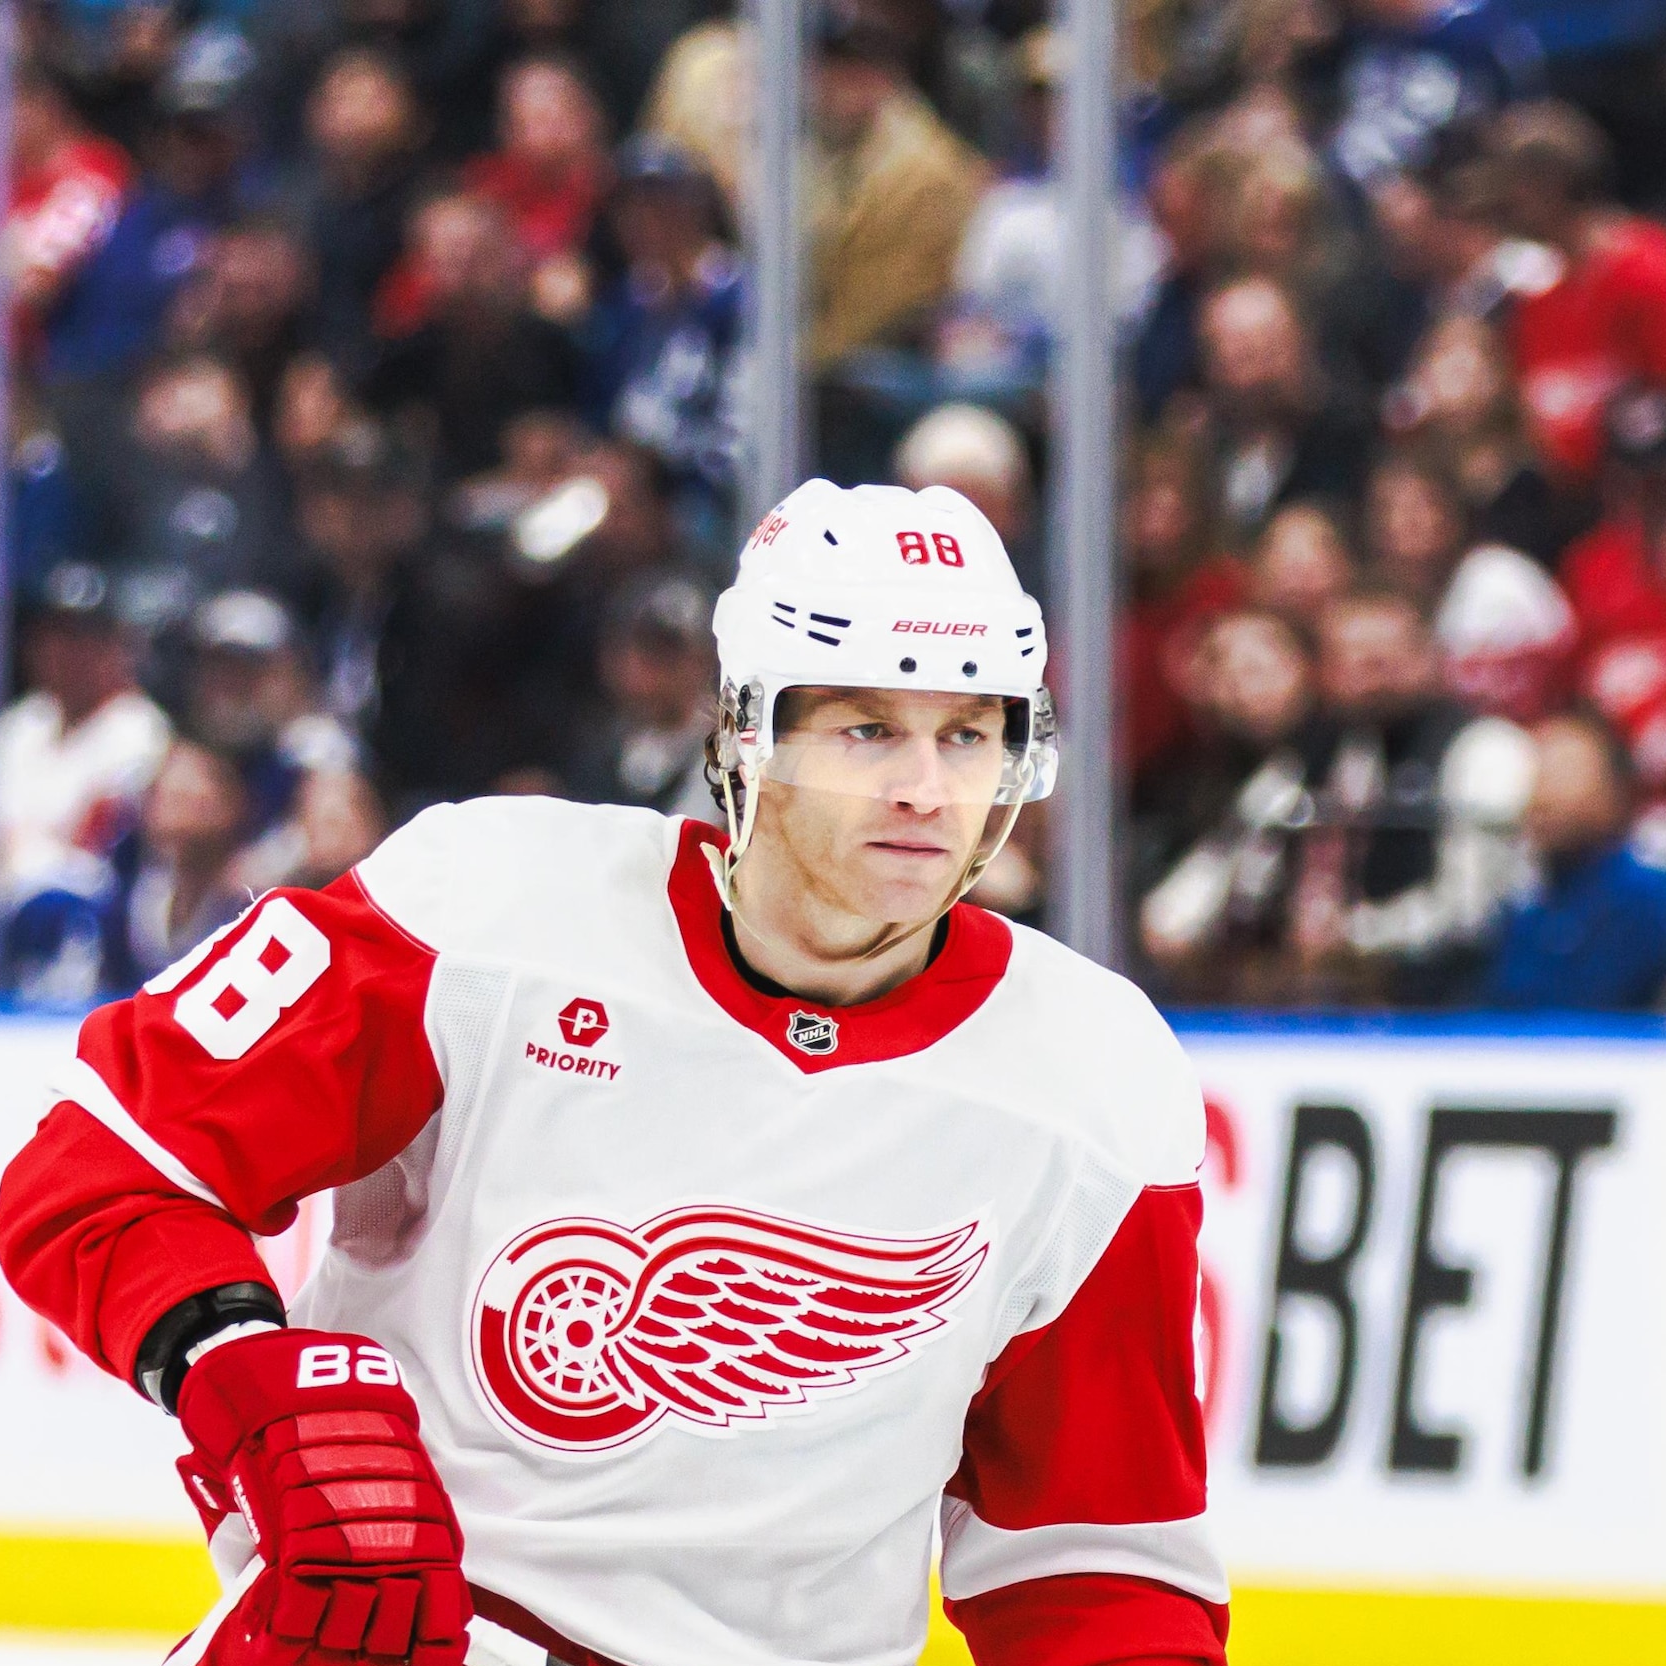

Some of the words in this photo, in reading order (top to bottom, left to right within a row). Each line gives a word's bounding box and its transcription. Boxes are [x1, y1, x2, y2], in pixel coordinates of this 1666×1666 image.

[895, 531, 965, 568] 88
[892, 620, 988, 637] BAUER
[144, 888, 331, 1060] 8
[798, 1026, 829, 1043] NHL
[526, 1042, 621, 1080] PRIORITY
[1201, 1098, 1621, 1482] BET
[296, 1344, 414, 1394] BA
